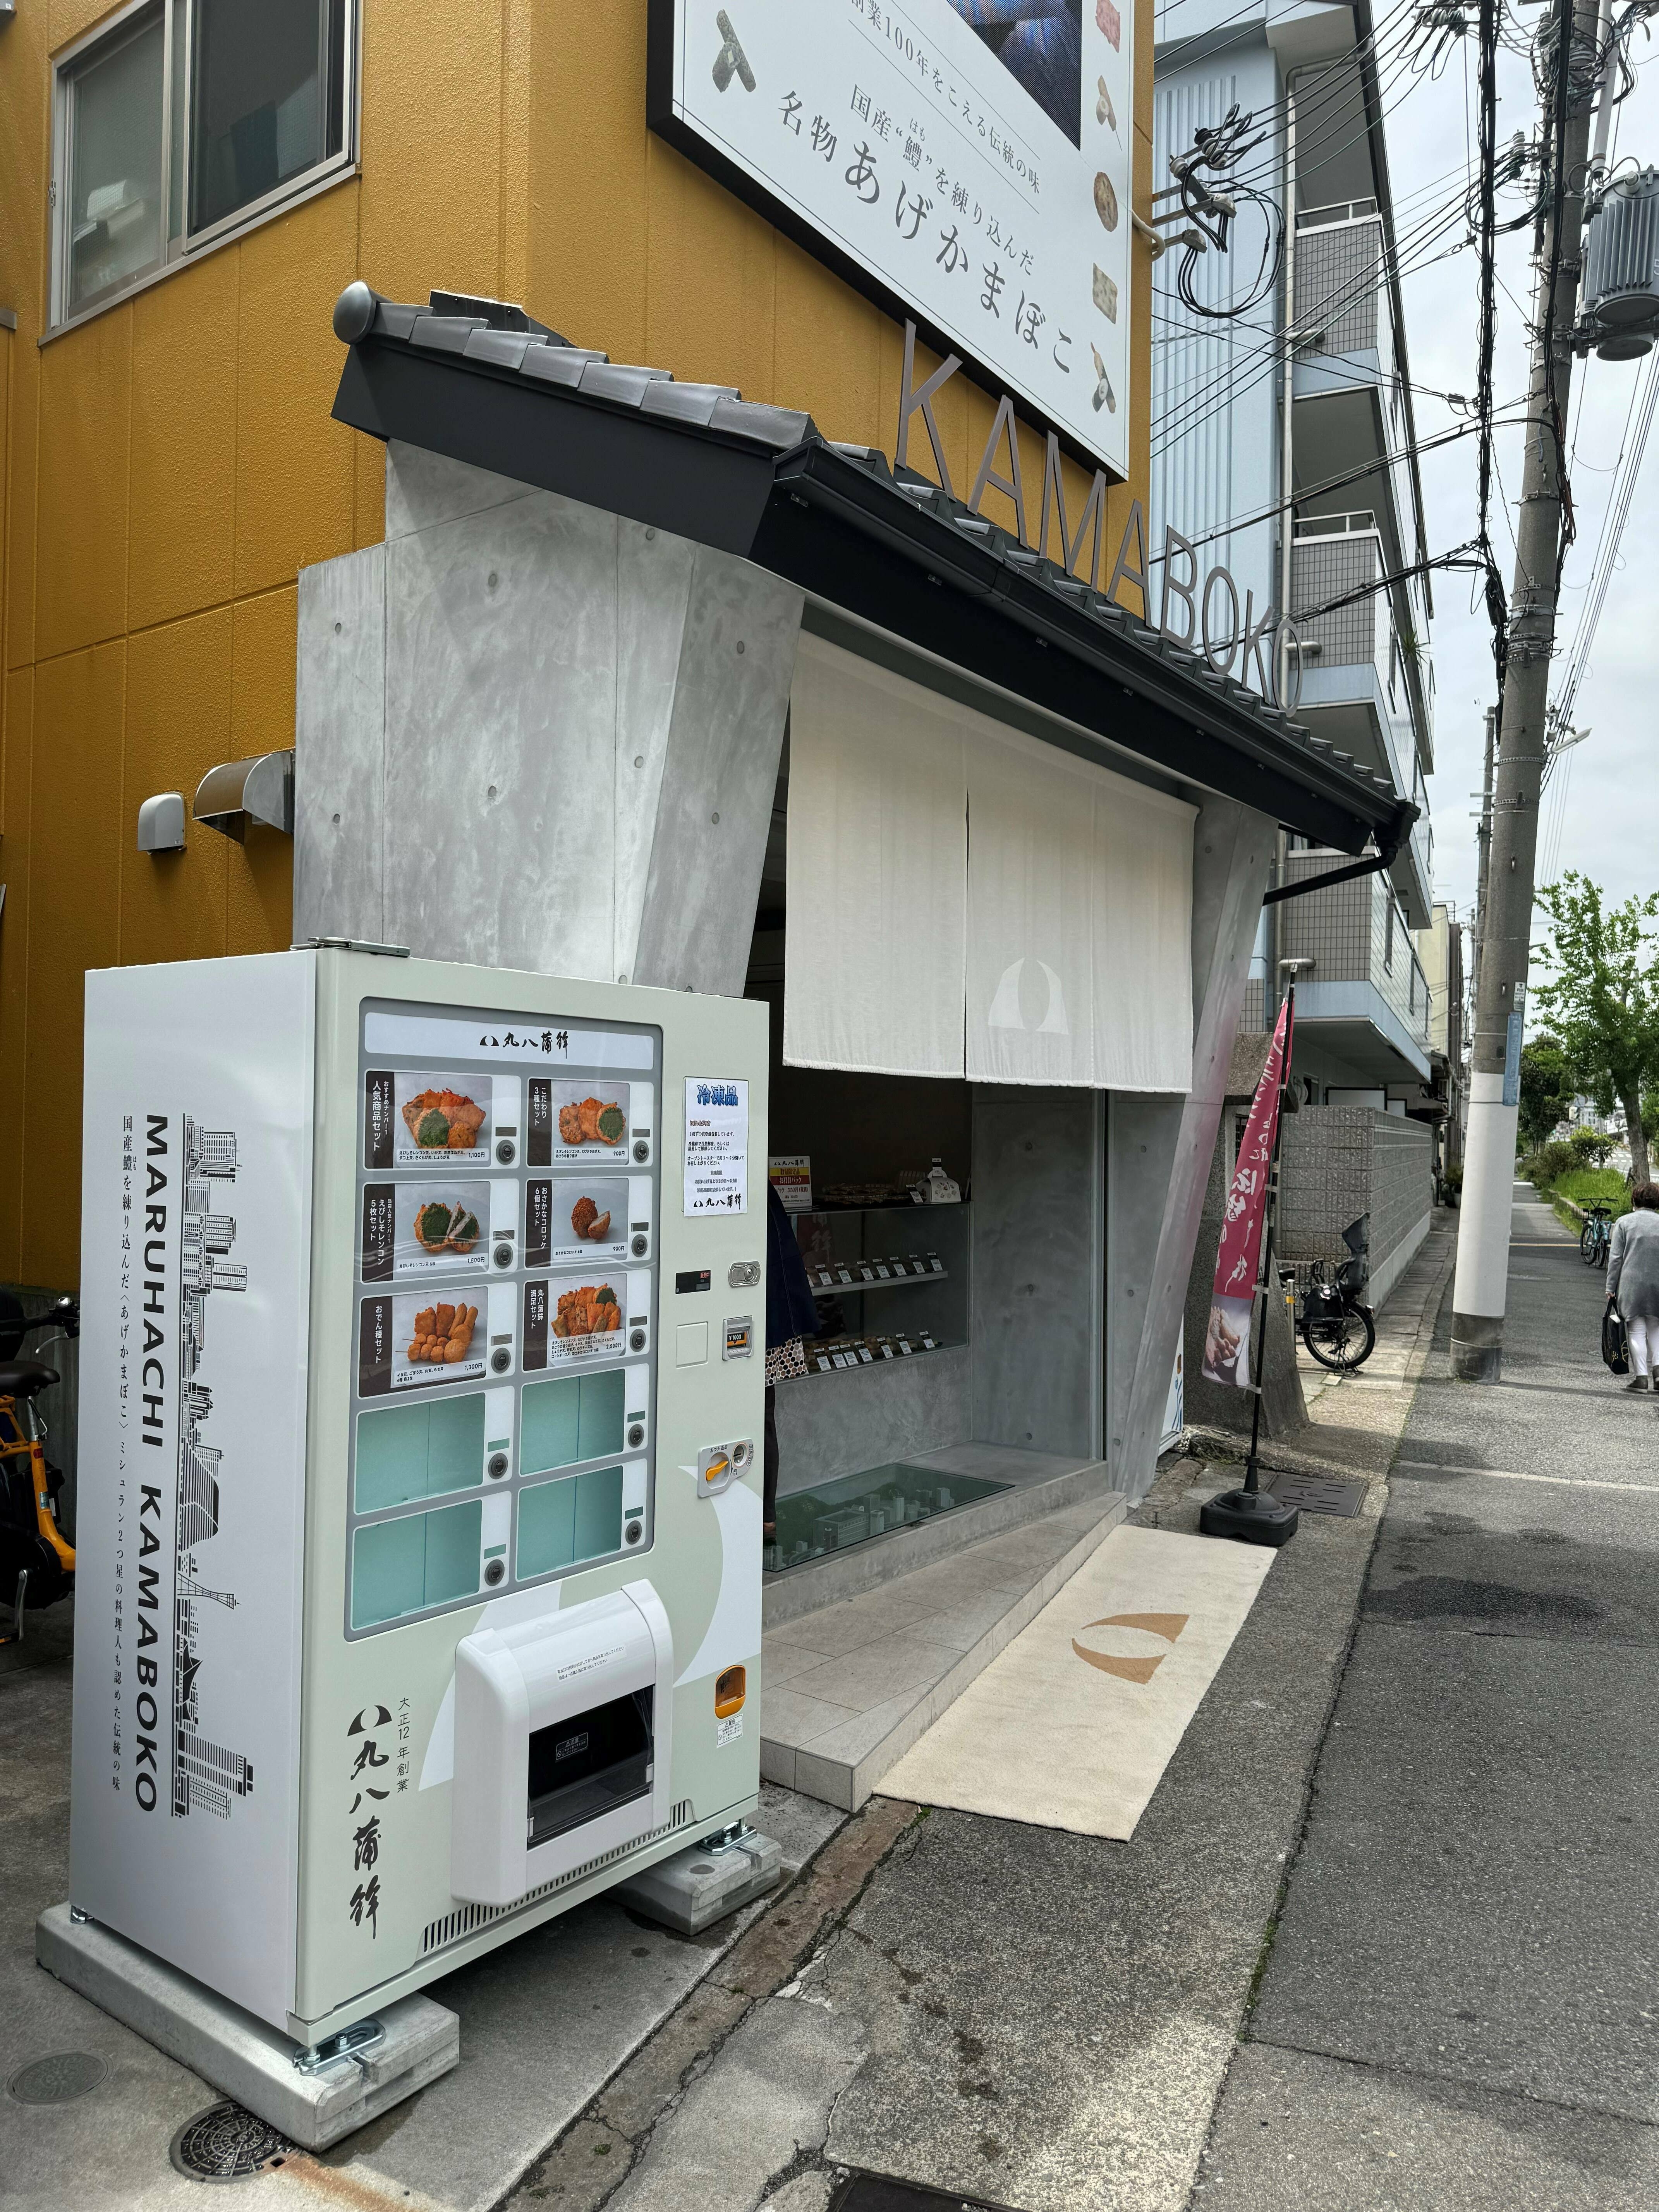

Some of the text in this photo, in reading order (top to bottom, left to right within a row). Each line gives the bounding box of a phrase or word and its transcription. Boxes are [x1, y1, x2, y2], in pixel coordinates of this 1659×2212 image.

[910, 117, 925, 141] はも
[778, 90, 1071, 374] 名物あげかまぼこ
[895, 318, 1303, 718] KAMABOKO
[373, 1080, 381, 1151] 人気商品セット
[697, 1084, 738, 1106] 冷凍品
[136, 1114, 168, 1812] MARUHACHI KAMABOKO
[397, 1697, 410, 1793] 大正12年創業
